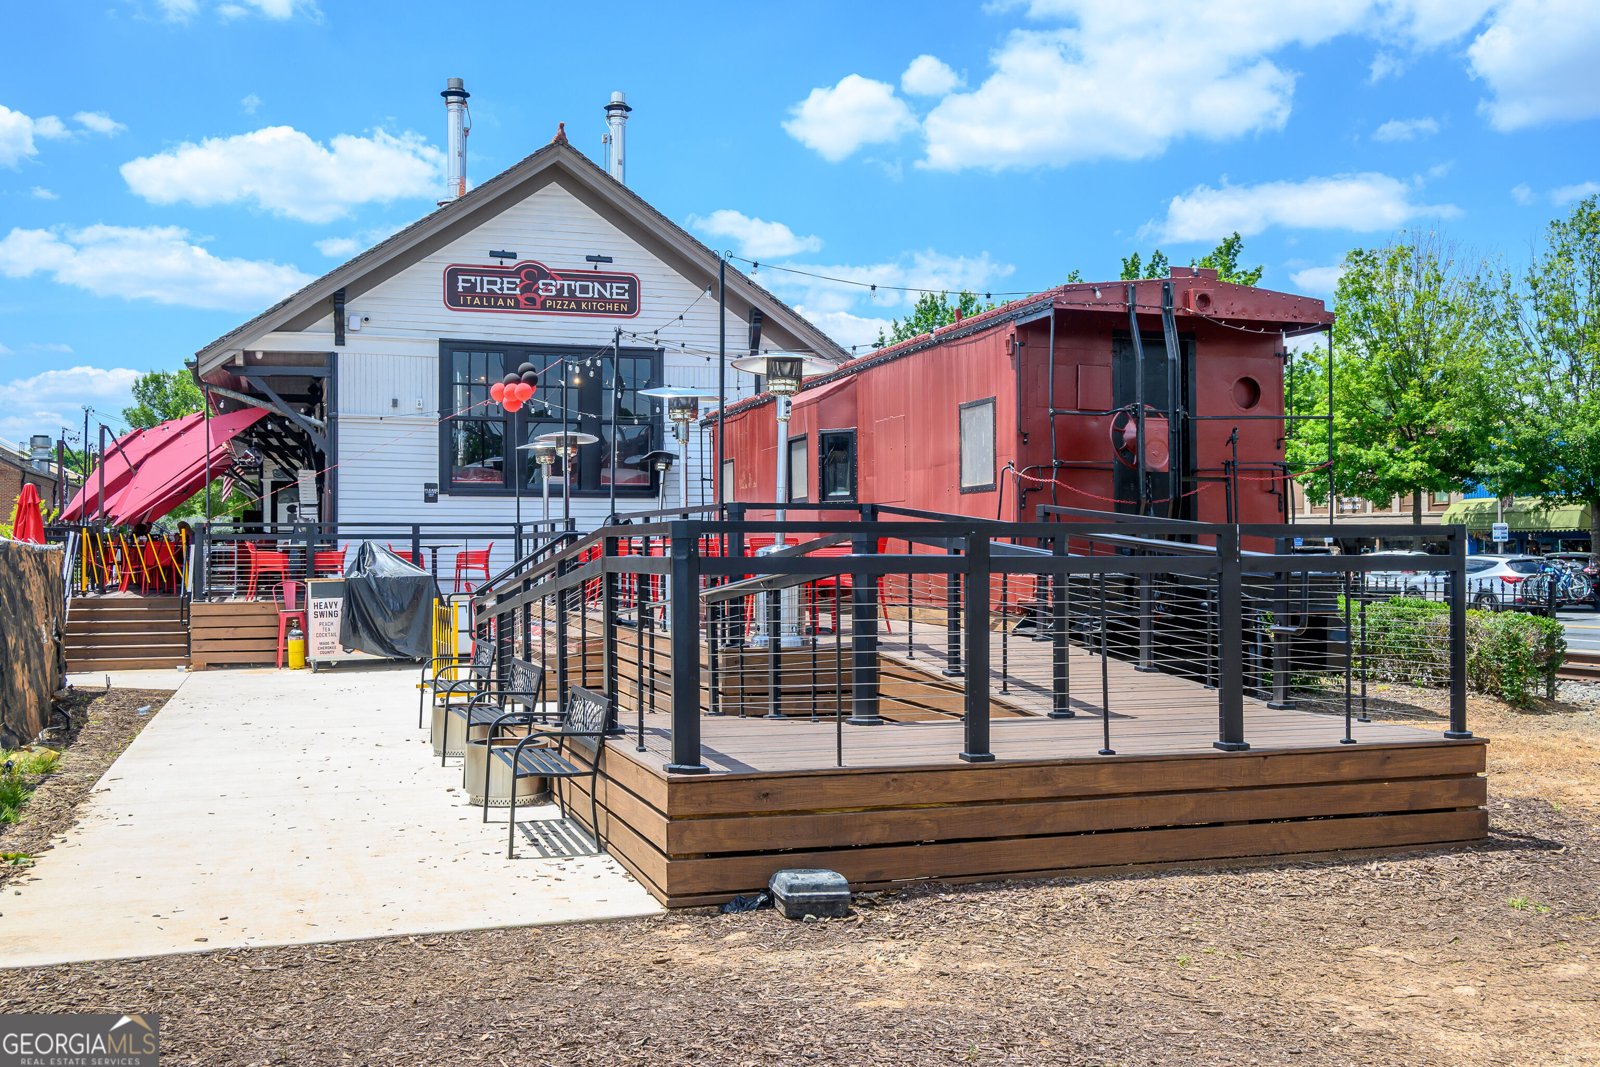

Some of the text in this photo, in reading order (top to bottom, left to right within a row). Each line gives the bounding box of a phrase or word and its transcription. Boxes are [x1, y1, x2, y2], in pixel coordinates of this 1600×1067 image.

[457, 275, 521, 295] FIRE
[538, 279, 630, 300] STONE
[460, 296, 628, 312] ITALIAN PIZZA KITCHEN
[314, 602, 338, 610] HEAVY
